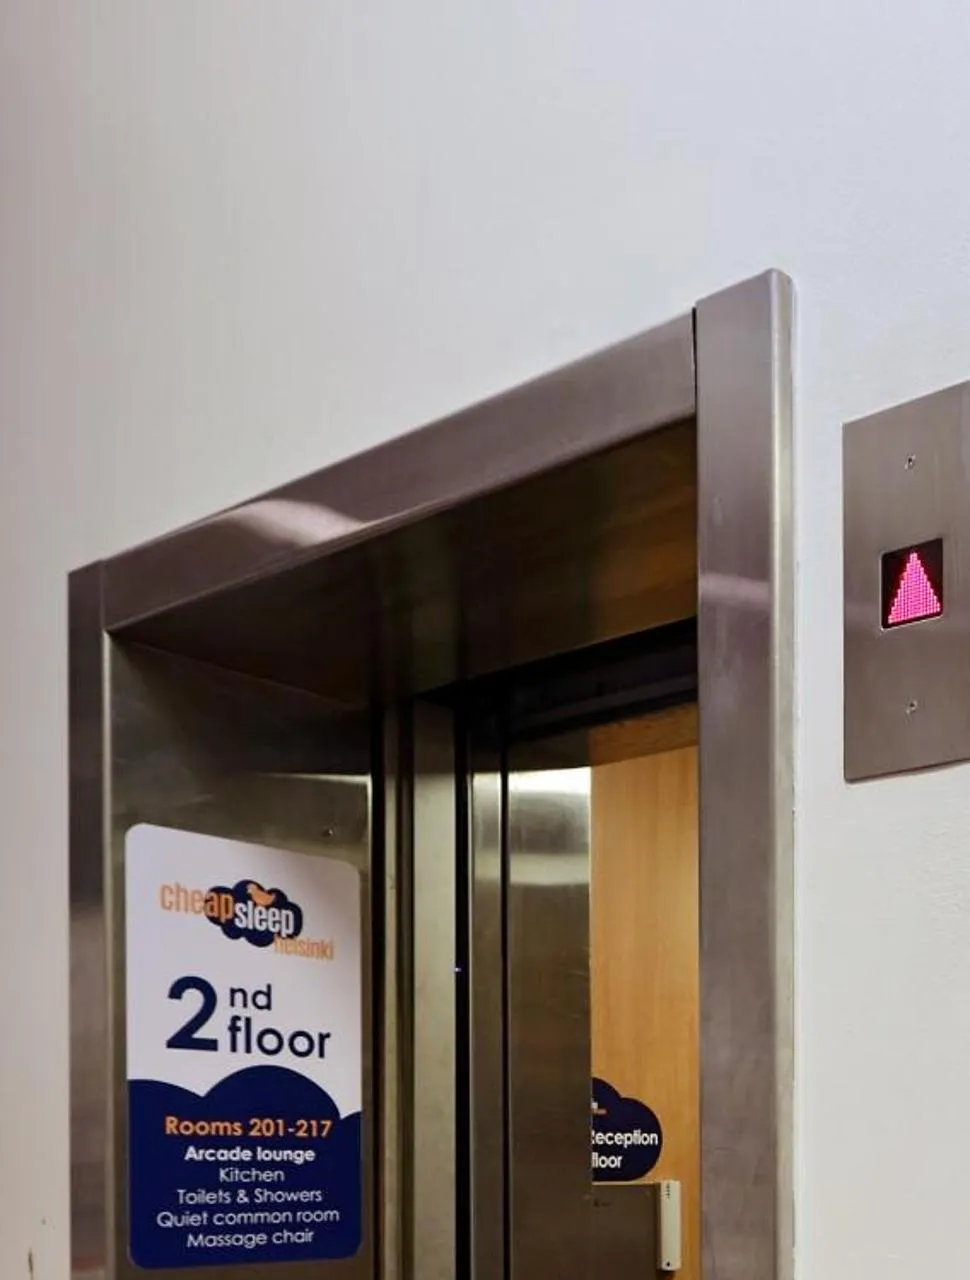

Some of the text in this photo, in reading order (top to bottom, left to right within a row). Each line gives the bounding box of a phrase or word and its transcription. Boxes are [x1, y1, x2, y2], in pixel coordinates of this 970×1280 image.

[228, 1014, 332, 1059] floor
[165, 1115, 332, 1138] Rooms 201-217
[184, 1145, 316, 1165] Arcade lounge
[219, 1166, 285, 1183] Kitchen
[177, 1187, 323, 1205] Toilets & Showers
[156, 1208, 340, 1228] Quiet common room
[186, 1228, 315, 1249] Massage chair
